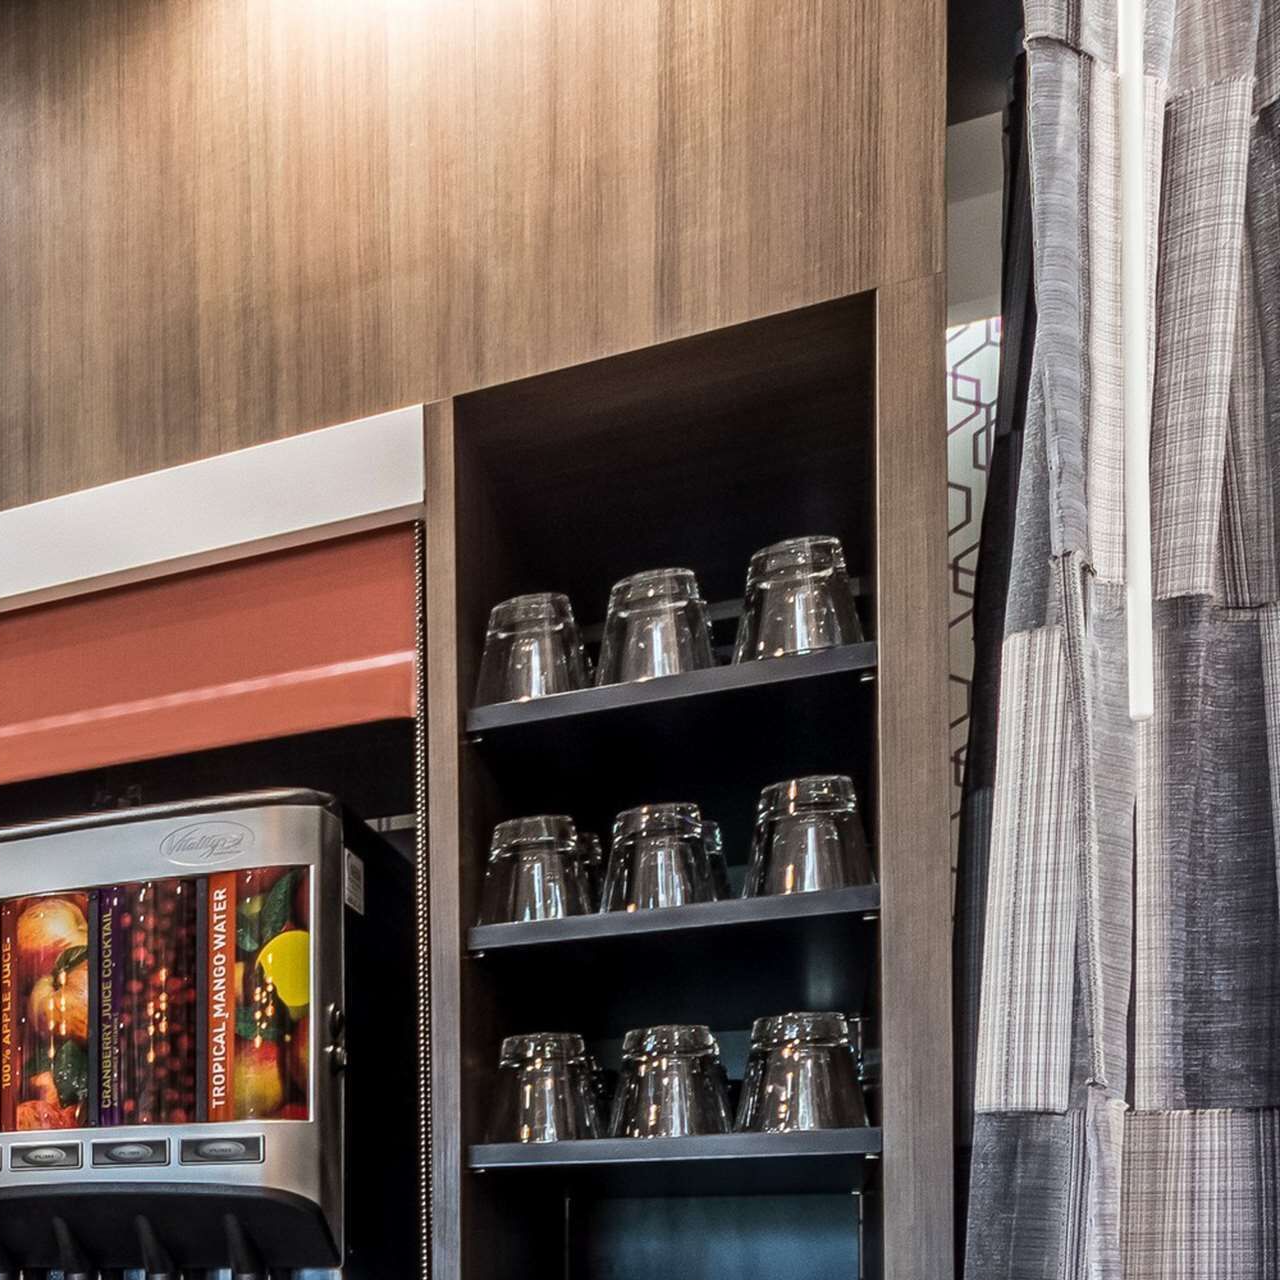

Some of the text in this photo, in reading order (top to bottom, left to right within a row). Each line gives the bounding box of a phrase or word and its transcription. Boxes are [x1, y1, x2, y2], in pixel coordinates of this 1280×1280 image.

[1, 943, 13, 1089] 100% APPLE JUICE
[101, 908, 113, 1109] CRANBERRY JUICE COCKTAIL
[211, 886, 228, 1109] TROPICAL MANGO WATER
